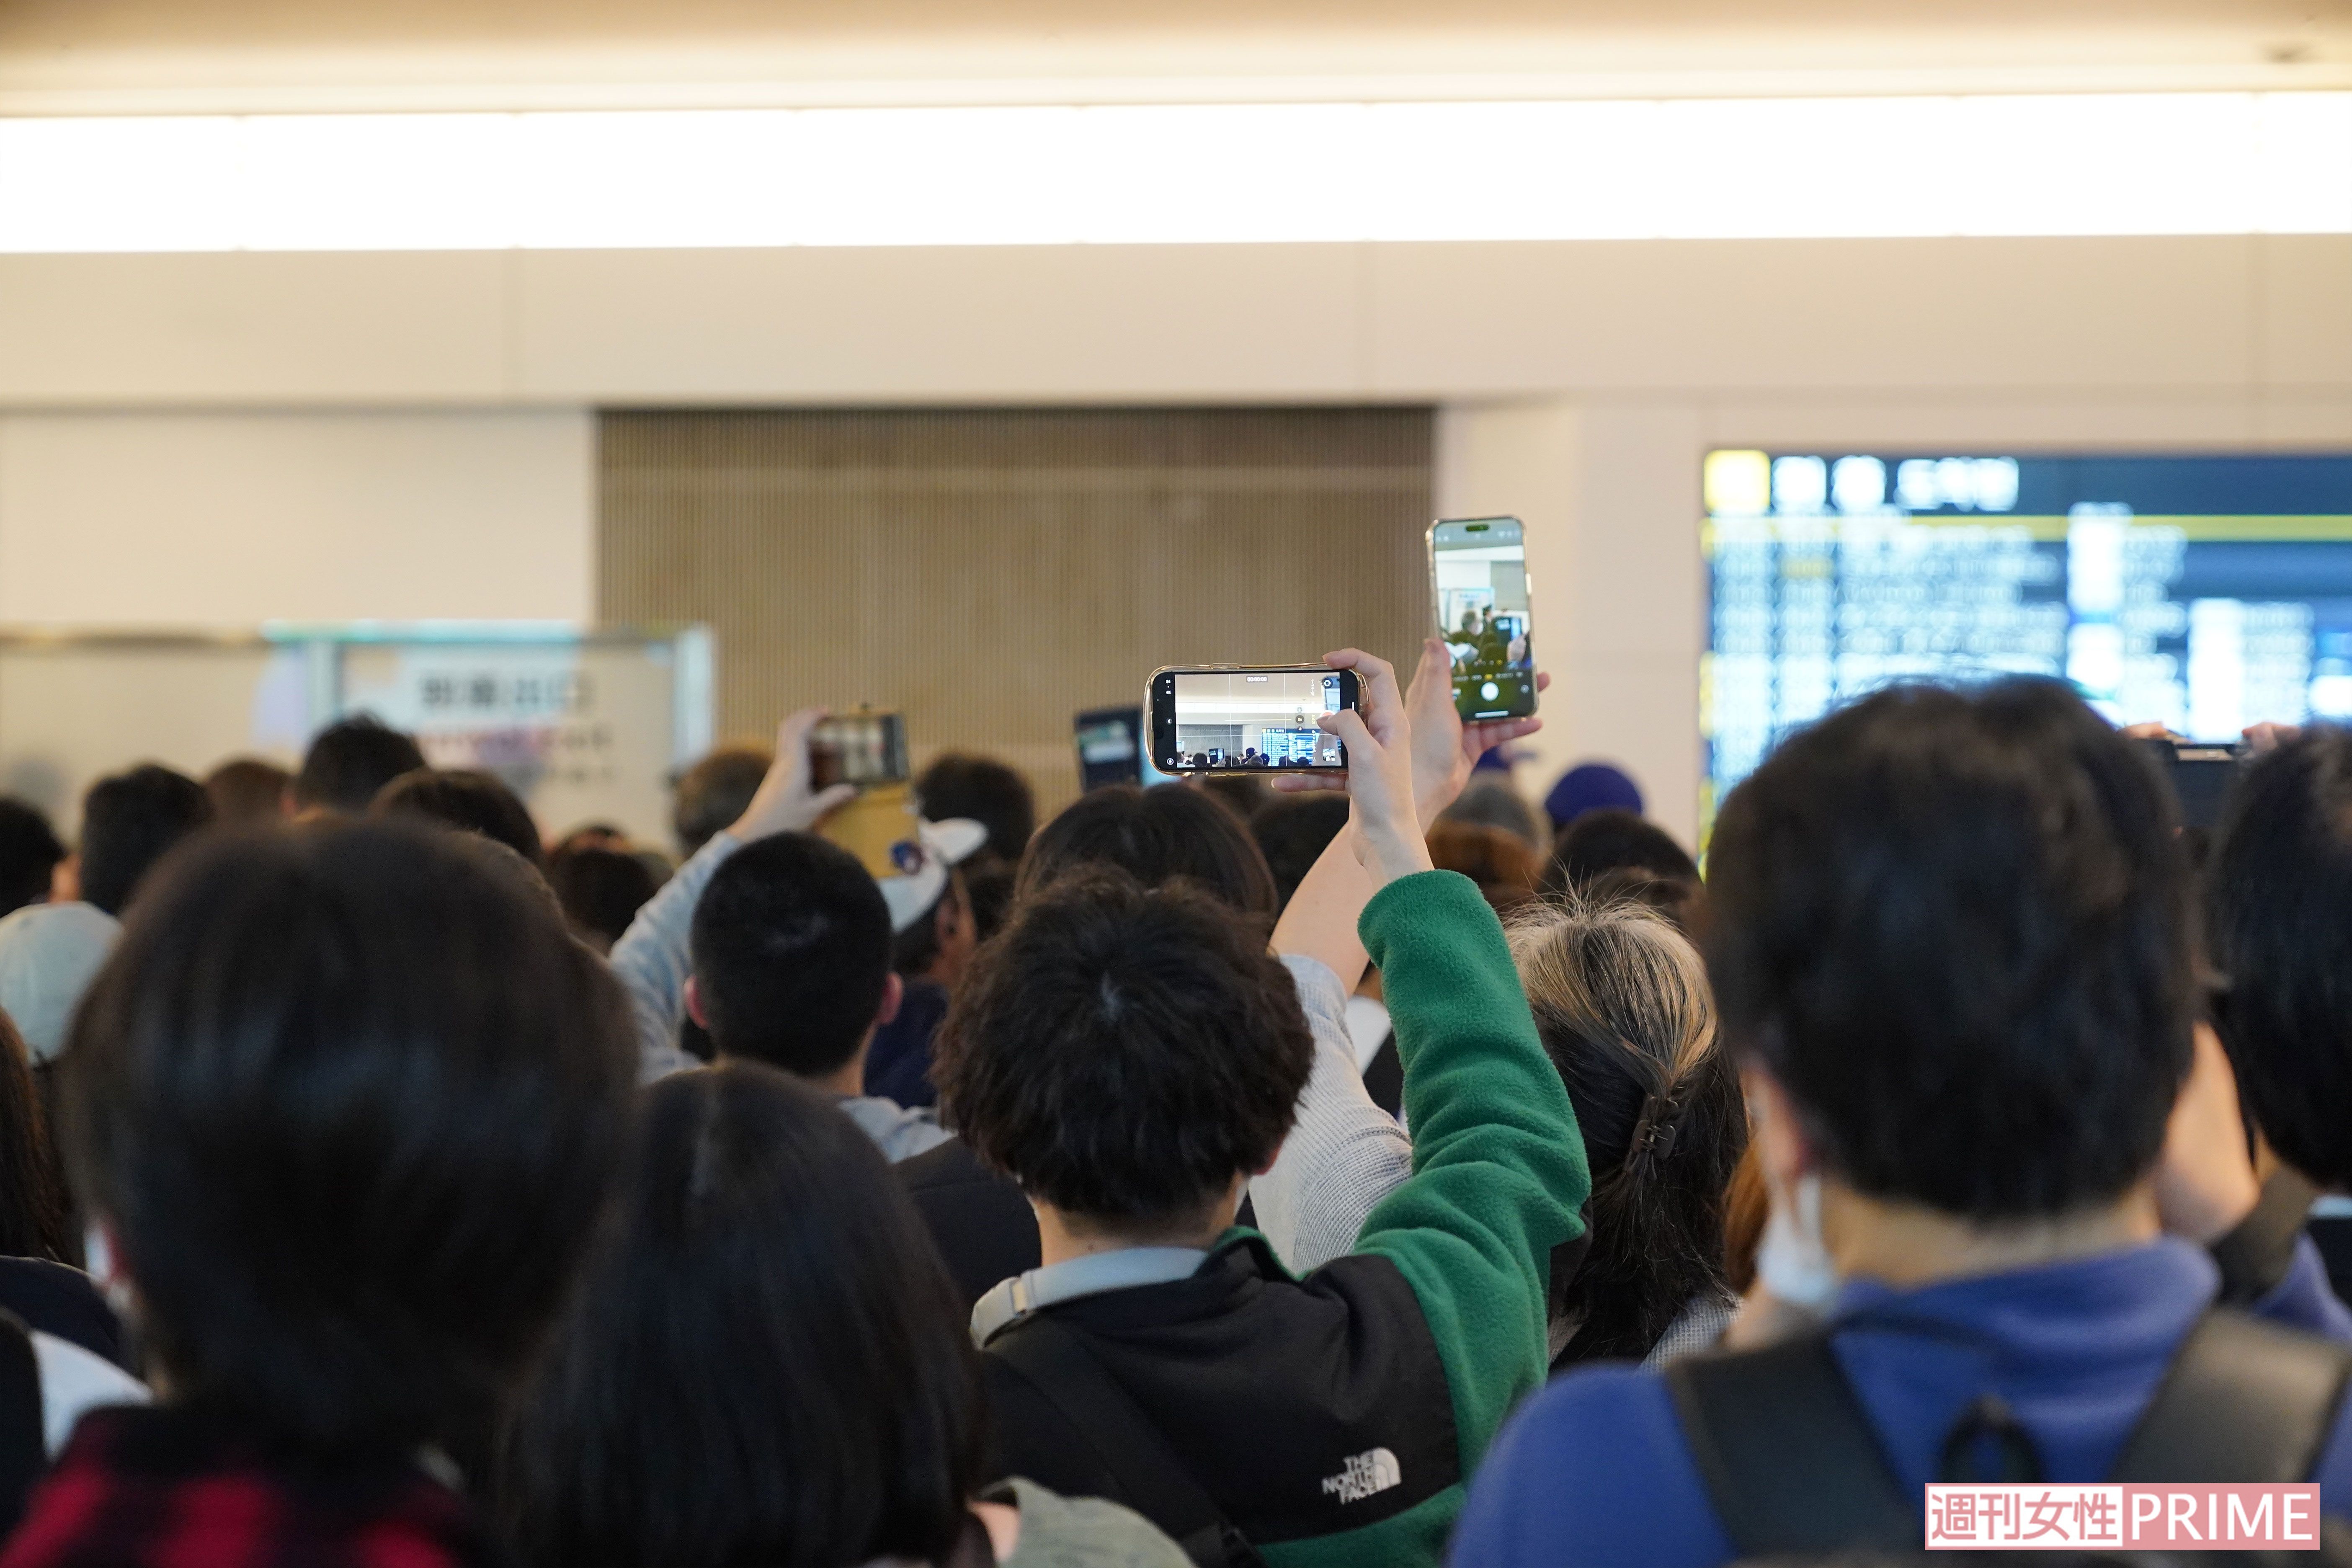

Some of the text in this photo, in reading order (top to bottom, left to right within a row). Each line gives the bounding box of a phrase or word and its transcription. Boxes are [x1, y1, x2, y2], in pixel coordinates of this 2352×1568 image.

[1343, 1451, 1374, 1475] THE
[1321, 1464, 1375, 1495] NORTH
[1339, 1478, 1377, 1505] FACE
